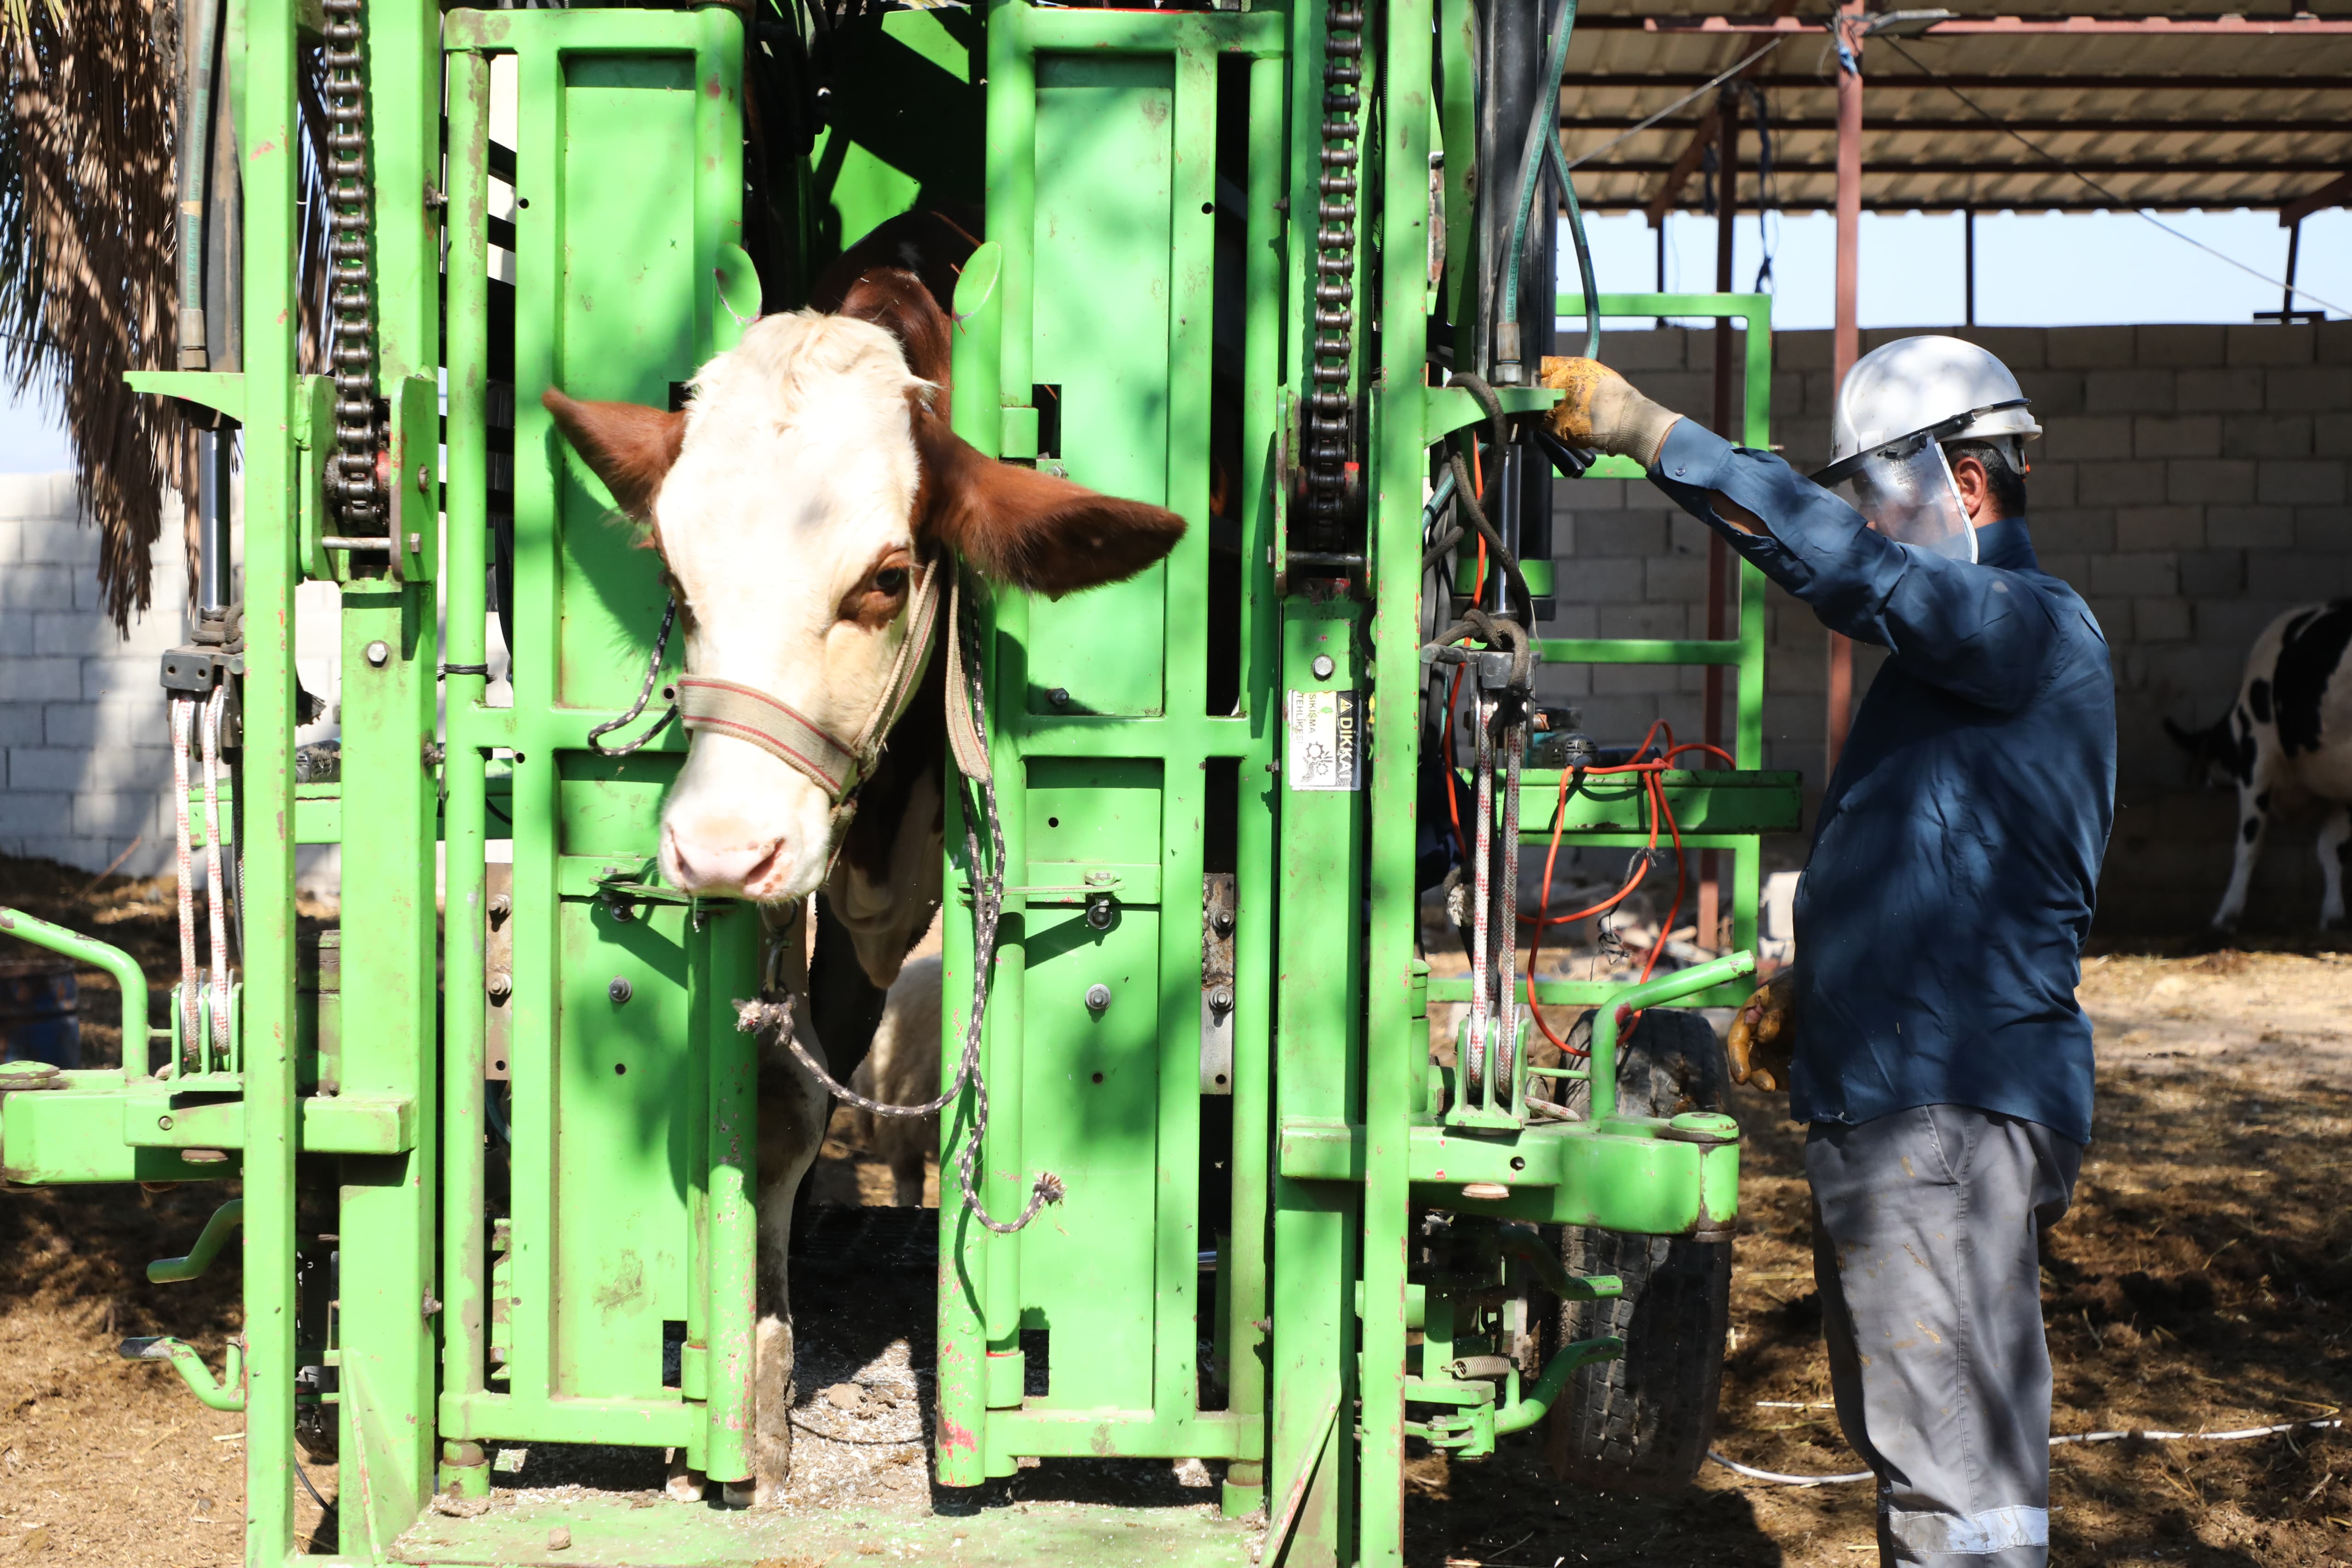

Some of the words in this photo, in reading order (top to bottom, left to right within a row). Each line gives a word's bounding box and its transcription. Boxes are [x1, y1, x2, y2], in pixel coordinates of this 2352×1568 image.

[1560, 17, 1572, 45] MADE
[1544, 85, 1556, 115] ARGUS
[1538, 123, 1546, 137] PSI
[1529, 162, 1537, 175] WP
[1520, 196, 1529, 218] R2AT
[1513, 237, 1521, 254] SAE
[1509, 257, 1518, 297] EXCEEDS
